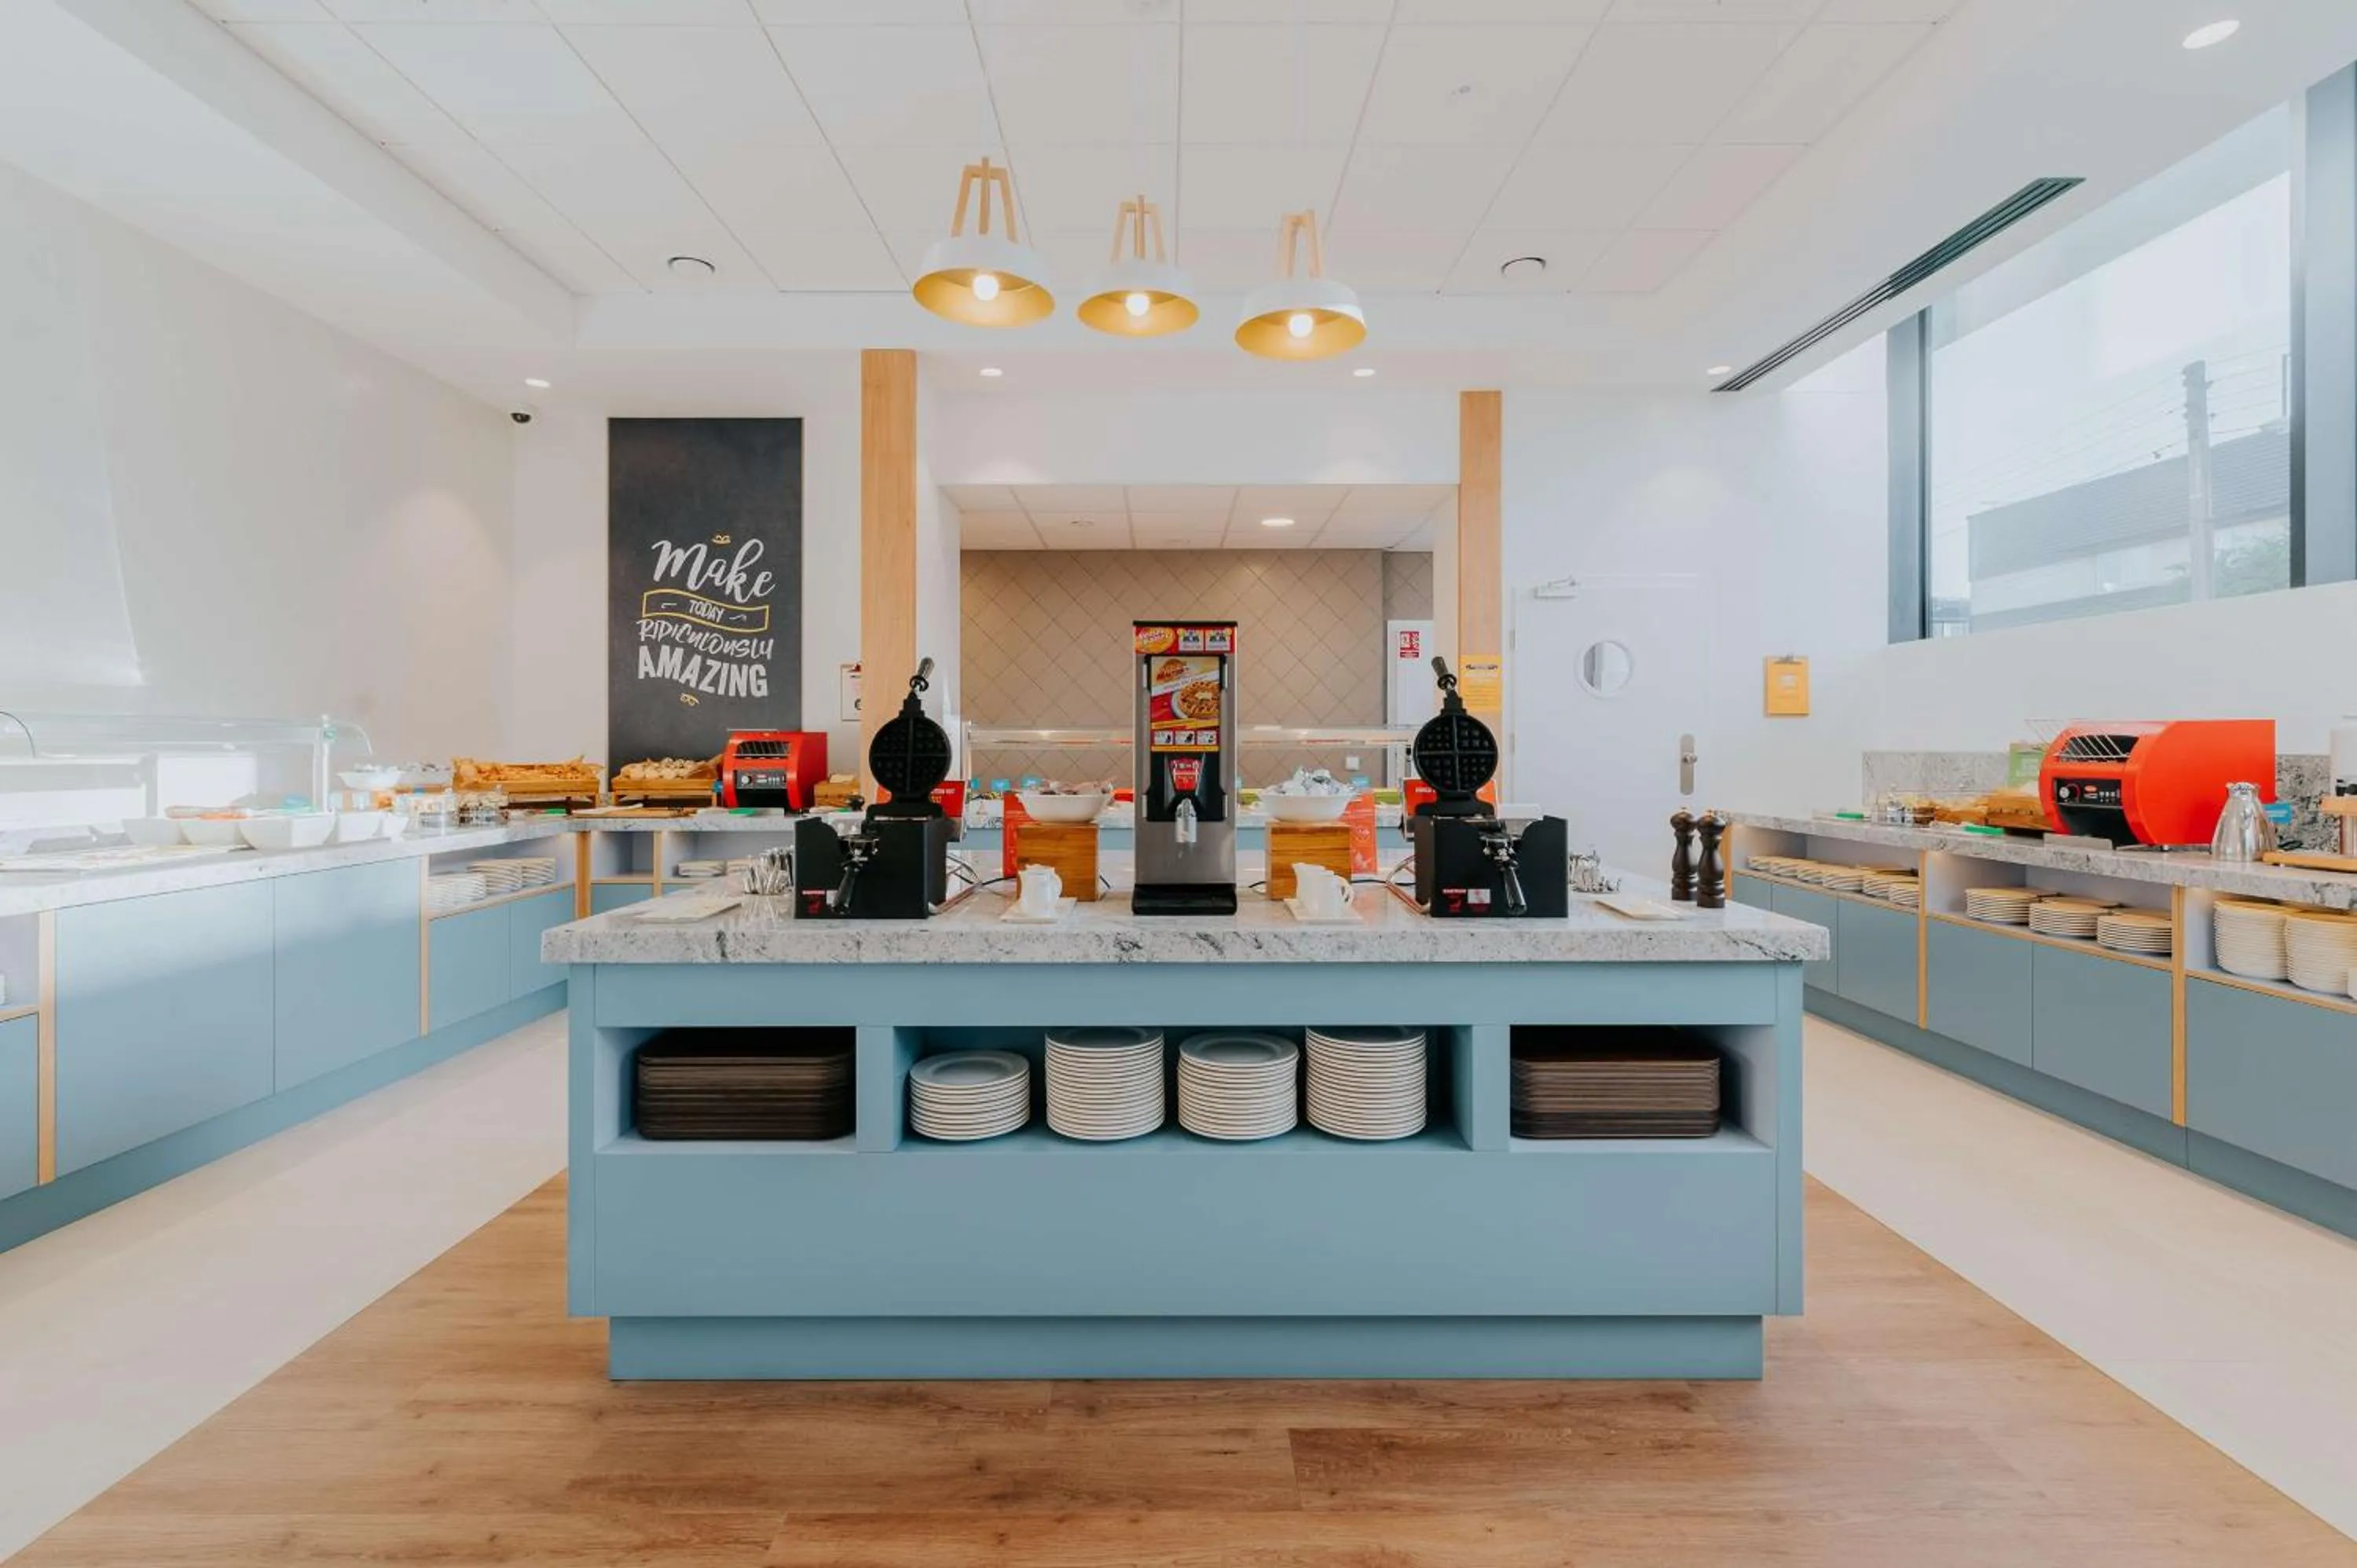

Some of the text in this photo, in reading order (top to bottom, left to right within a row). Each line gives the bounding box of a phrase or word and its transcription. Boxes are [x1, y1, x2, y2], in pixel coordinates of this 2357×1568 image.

[651, 539, 776, 603] Make
[689, 599, 724, 623] TODAY
[637, 644, 768, 698] AMAZING
